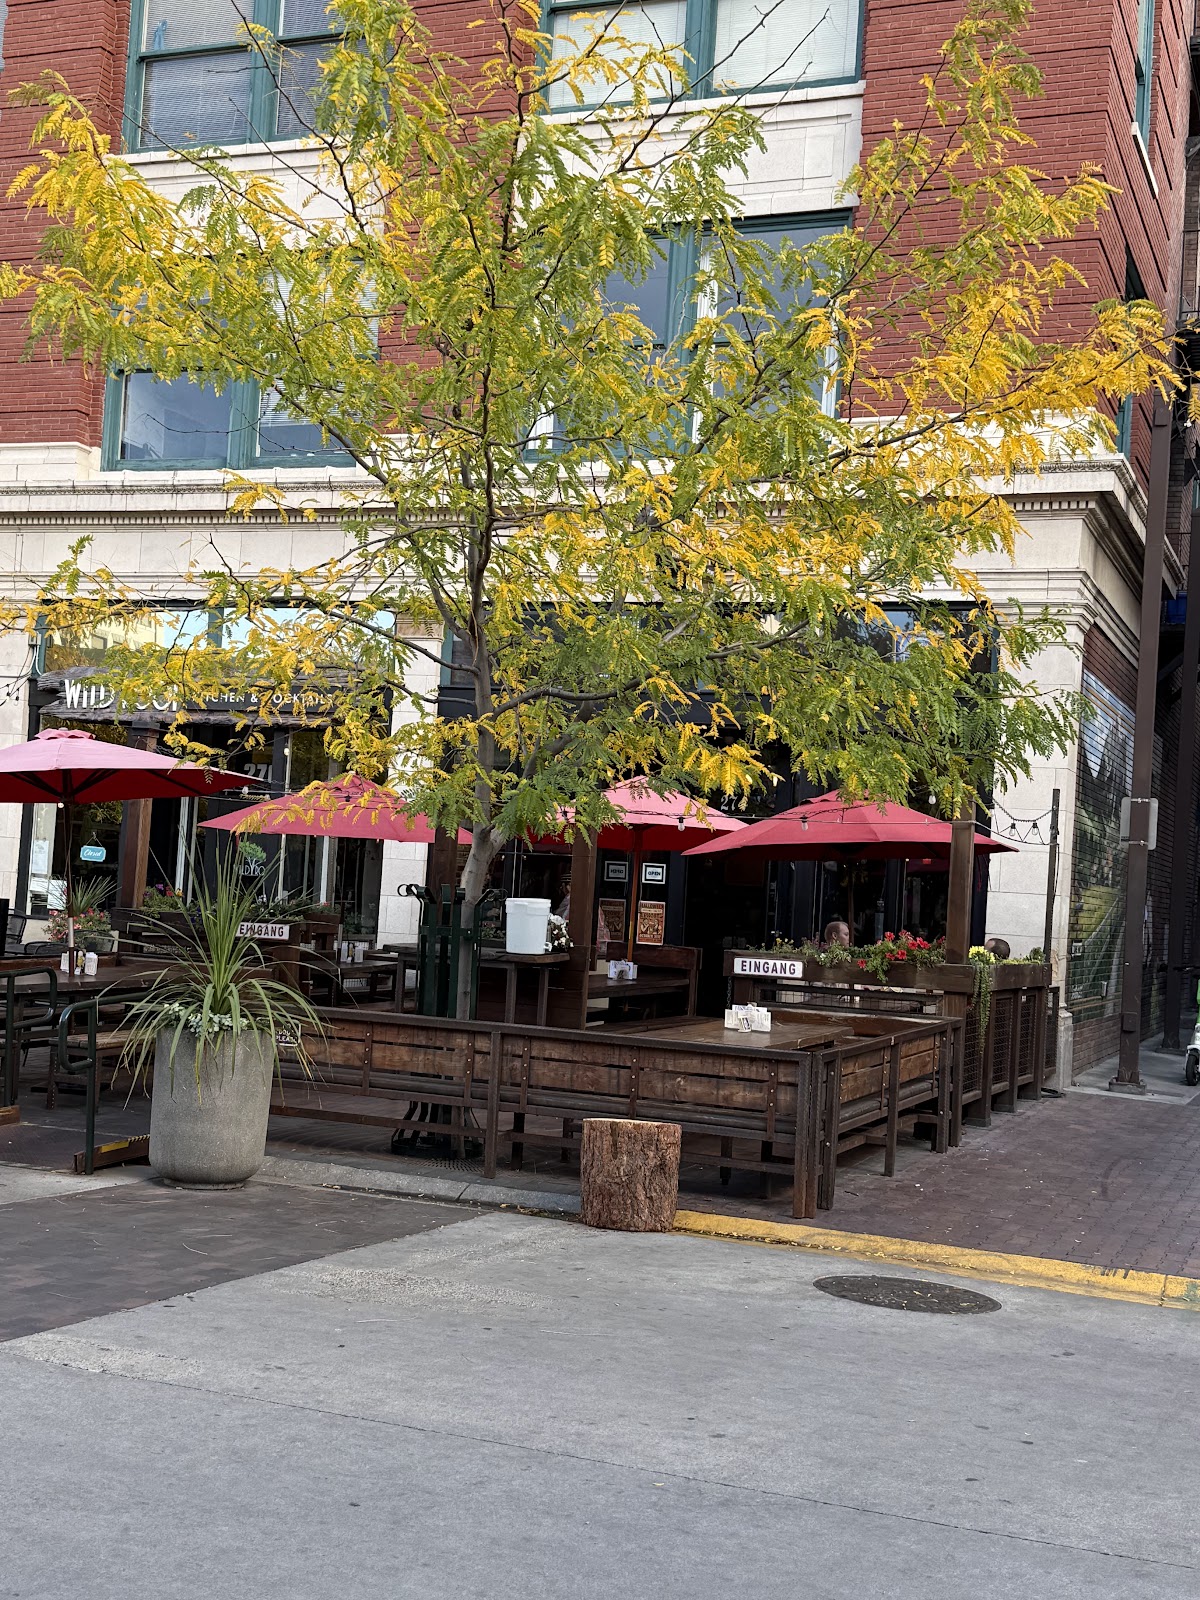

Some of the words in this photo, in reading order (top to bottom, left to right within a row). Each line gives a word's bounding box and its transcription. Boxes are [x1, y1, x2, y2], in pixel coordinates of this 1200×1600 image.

[192, 692, 245, 703] ITCHEN
[250, 694, 258, 703] &
[273, 693, 333, 705] OCKTAILS
[240, 924, 284, 937] EINGANG
[741, 959, 796, 975] EINGANG
